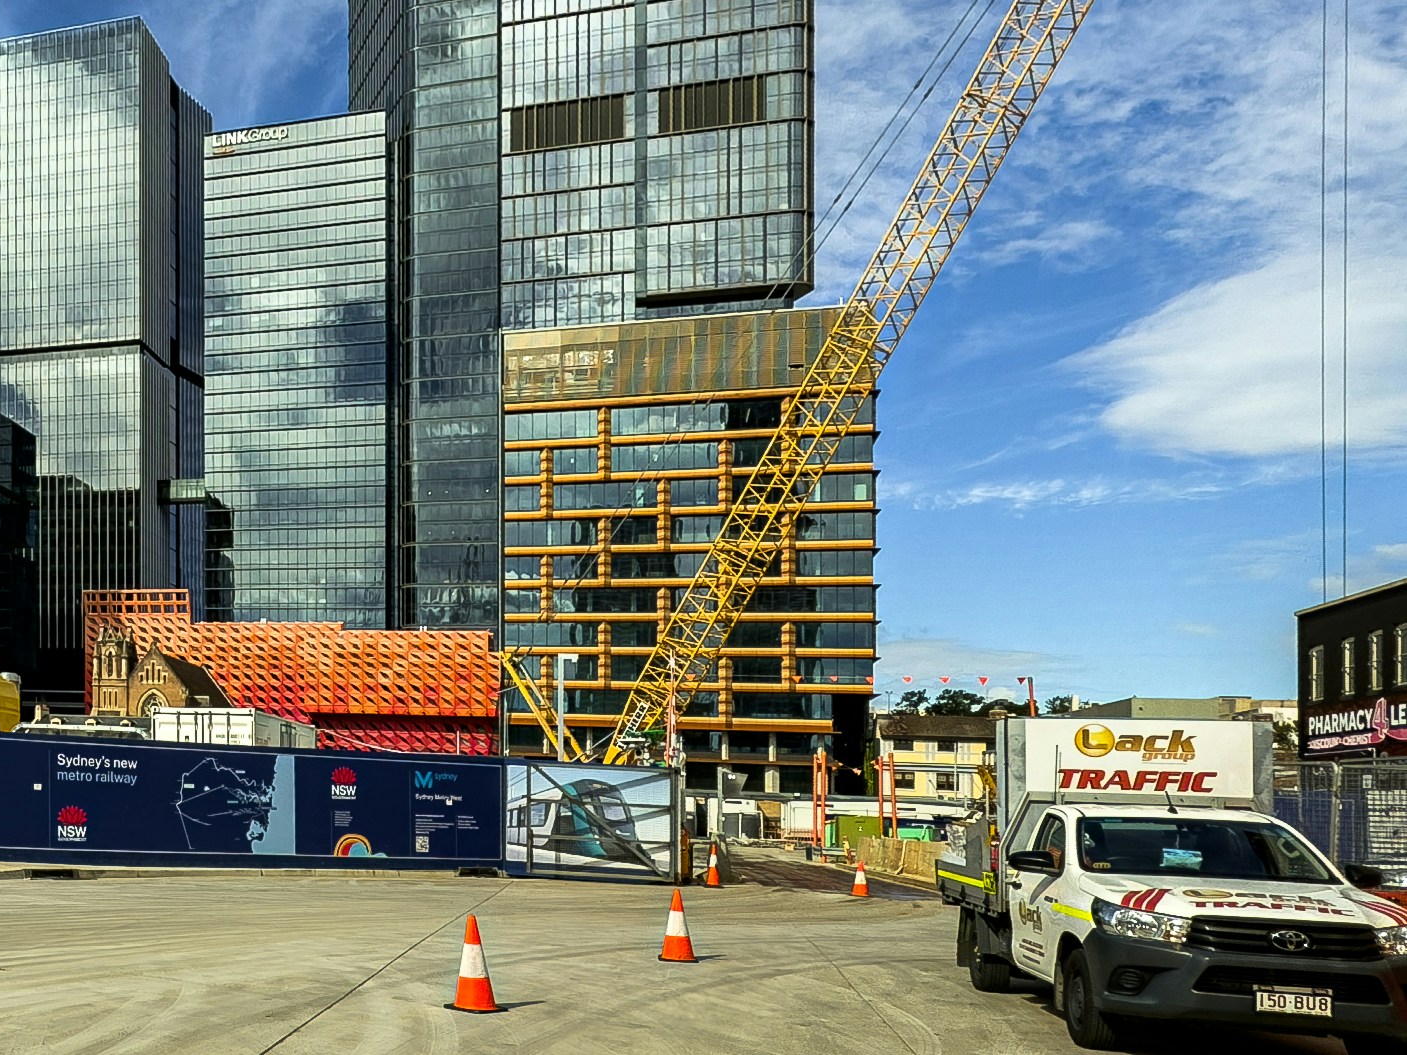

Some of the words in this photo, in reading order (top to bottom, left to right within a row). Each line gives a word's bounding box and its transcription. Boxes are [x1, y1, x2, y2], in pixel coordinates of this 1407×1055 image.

[1308, 708, 1374, 736] PHARMACY
[1372, 697, 1389, 739] 4
[1074, 724, 1197, 757] Lack
[57, 753, 111, 770] Sydney's
[113, 759, 138, 769] new
[1141, 752, 1196, 763] group
[56, 770, 93, 782] metro
[95, 770, 138, 786] railway
[434, 773, 459, 782] sydney
[1057, 769, 1218, 793] TRAFFIC
[332, 784, 357, 796] NSW
[57, 825, 88, 837] NSW
